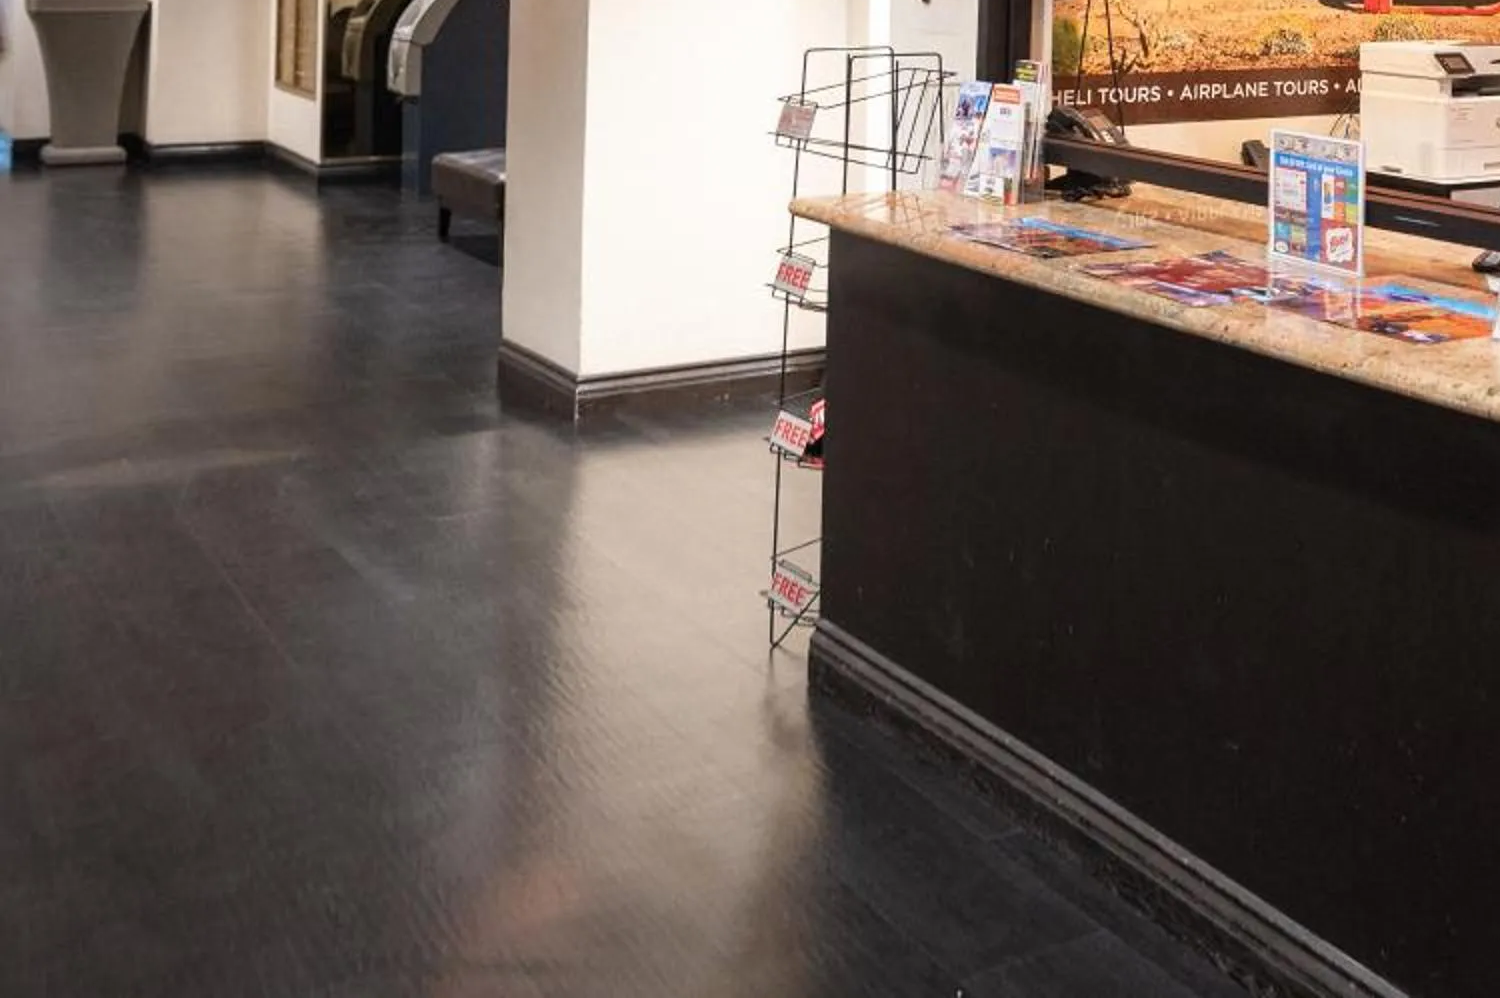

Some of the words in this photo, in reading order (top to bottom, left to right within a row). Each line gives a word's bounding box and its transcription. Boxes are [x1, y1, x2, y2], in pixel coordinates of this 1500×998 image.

[1098, 85, 1161, 105] TOURS
[1180, 81, 1268, 102] AIRPLANE
[1274, 78, 1329, 98] TOURS
[776, 262, 811, 290] FREE
[774, 416, 809, 446] FREE
[771, 571, 808, 607] FREE
